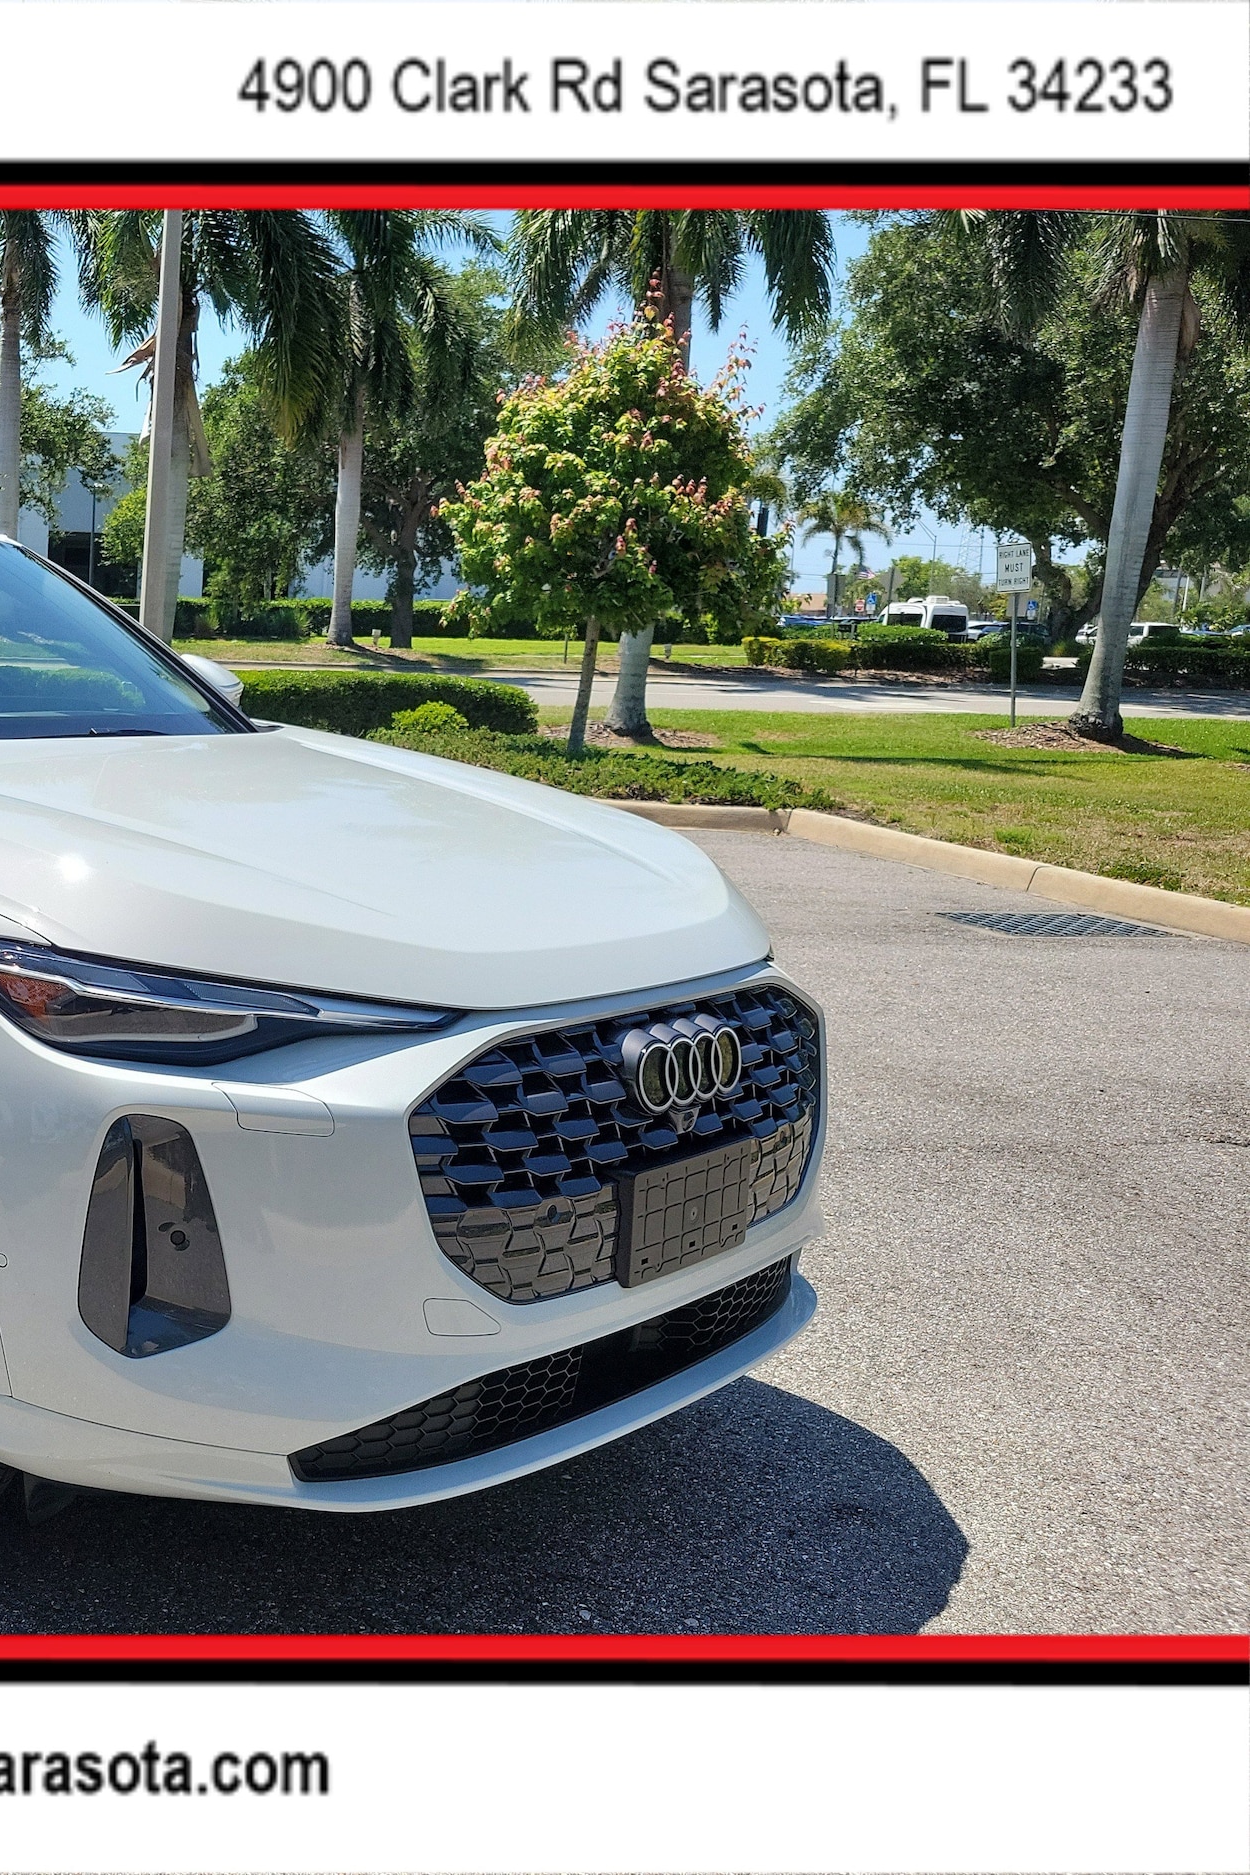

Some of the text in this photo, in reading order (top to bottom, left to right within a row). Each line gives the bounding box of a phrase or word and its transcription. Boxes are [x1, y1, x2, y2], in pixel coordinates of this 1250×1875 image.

[999, 549, 1029, 559] RIGHT LANE
[1005, 562, 1023, 572] MUST
[1014, 577, 1029, 585] RIGHT
